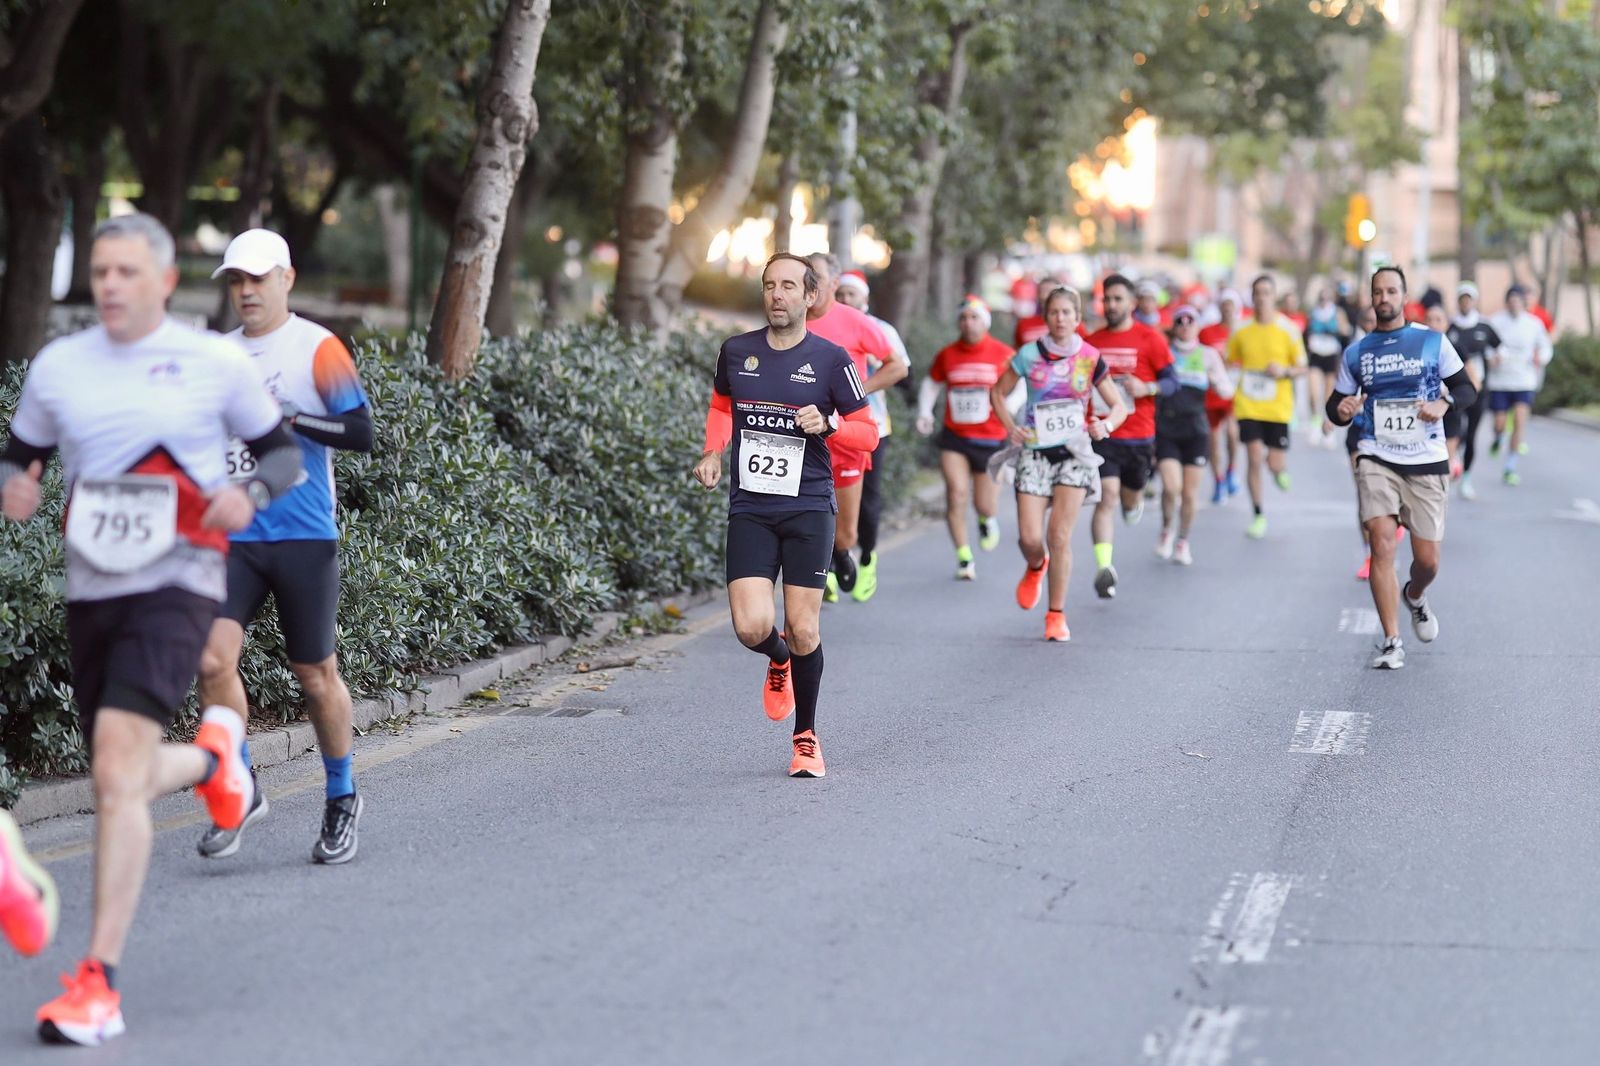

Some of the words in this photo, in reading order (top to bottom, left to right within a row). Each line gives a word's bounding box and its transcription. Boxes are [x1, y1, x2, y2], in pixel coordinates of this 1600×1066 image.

[1375, 353, 1405, 364] MEDIA
[755, 404, 787, 412] MARATHON
[746, 414, 795, 430] OSCAR
[1046, 415, 1076, 432] 636
[1384, 416, 1416, 431] 412
[748, 454, 789, 478] 623
[90, 510, 153, 542] 795
